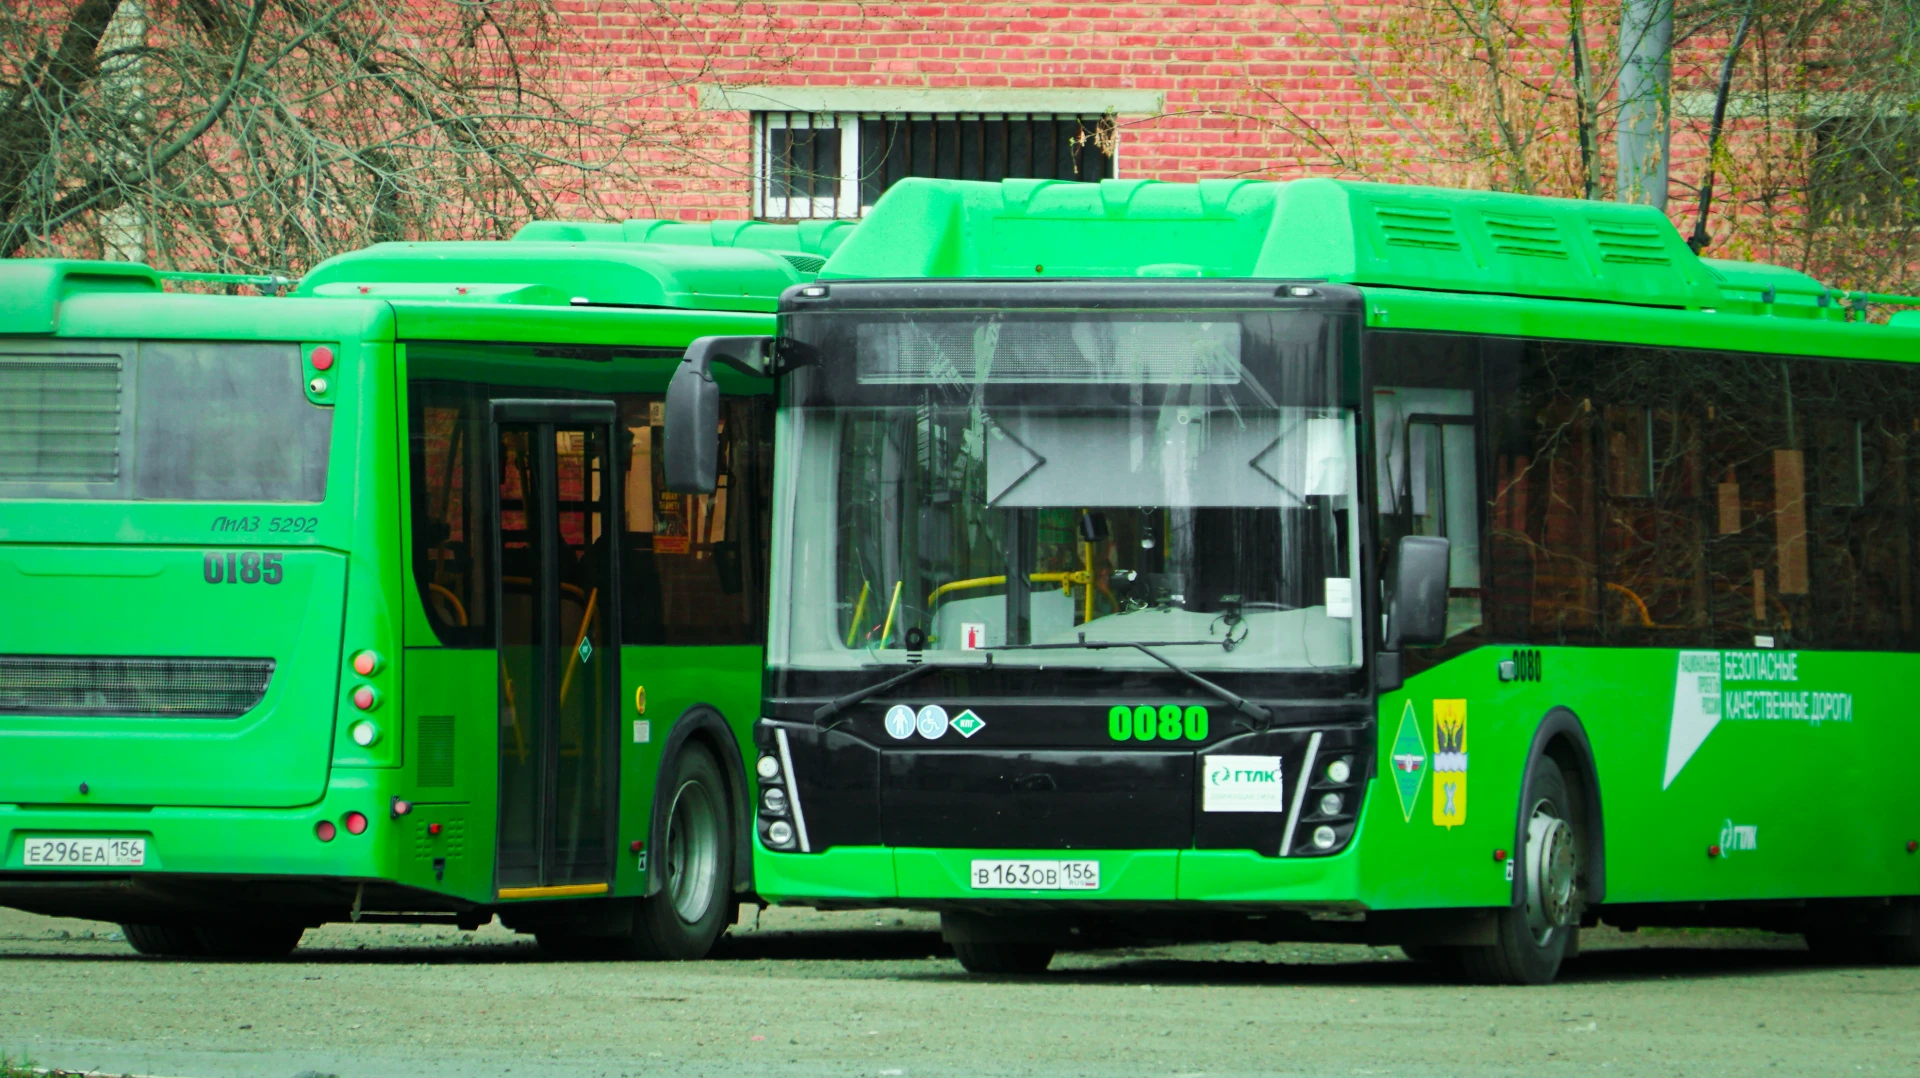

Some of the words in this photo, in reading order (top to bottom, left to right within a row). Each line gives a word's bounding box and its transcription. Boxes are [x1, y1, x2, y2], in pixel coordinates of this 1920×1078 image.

[268, 517, 318, 533] 5292
[203, 552, 283, 584] 0185
[1512, 649, 1541, 682] 0080
[1725, 652, 1798, 681] БЕЗОПАСНЫЕ
[1108, 704, 1209, 741] 0080
[1726, 691, 1810, 720] КАЧЕСТВЕННЫЕ
[1810, 692, 1852, 726] ДОРОГИ
[1235, 770, 1276, 783] ГТЛК
[29, 842, 105, 862] Е296ЕА
[111, 841, 138, 857] 156
[978, 864, 1057, 885] В163ОВ
[1063, 864, 1093, 879] 156
